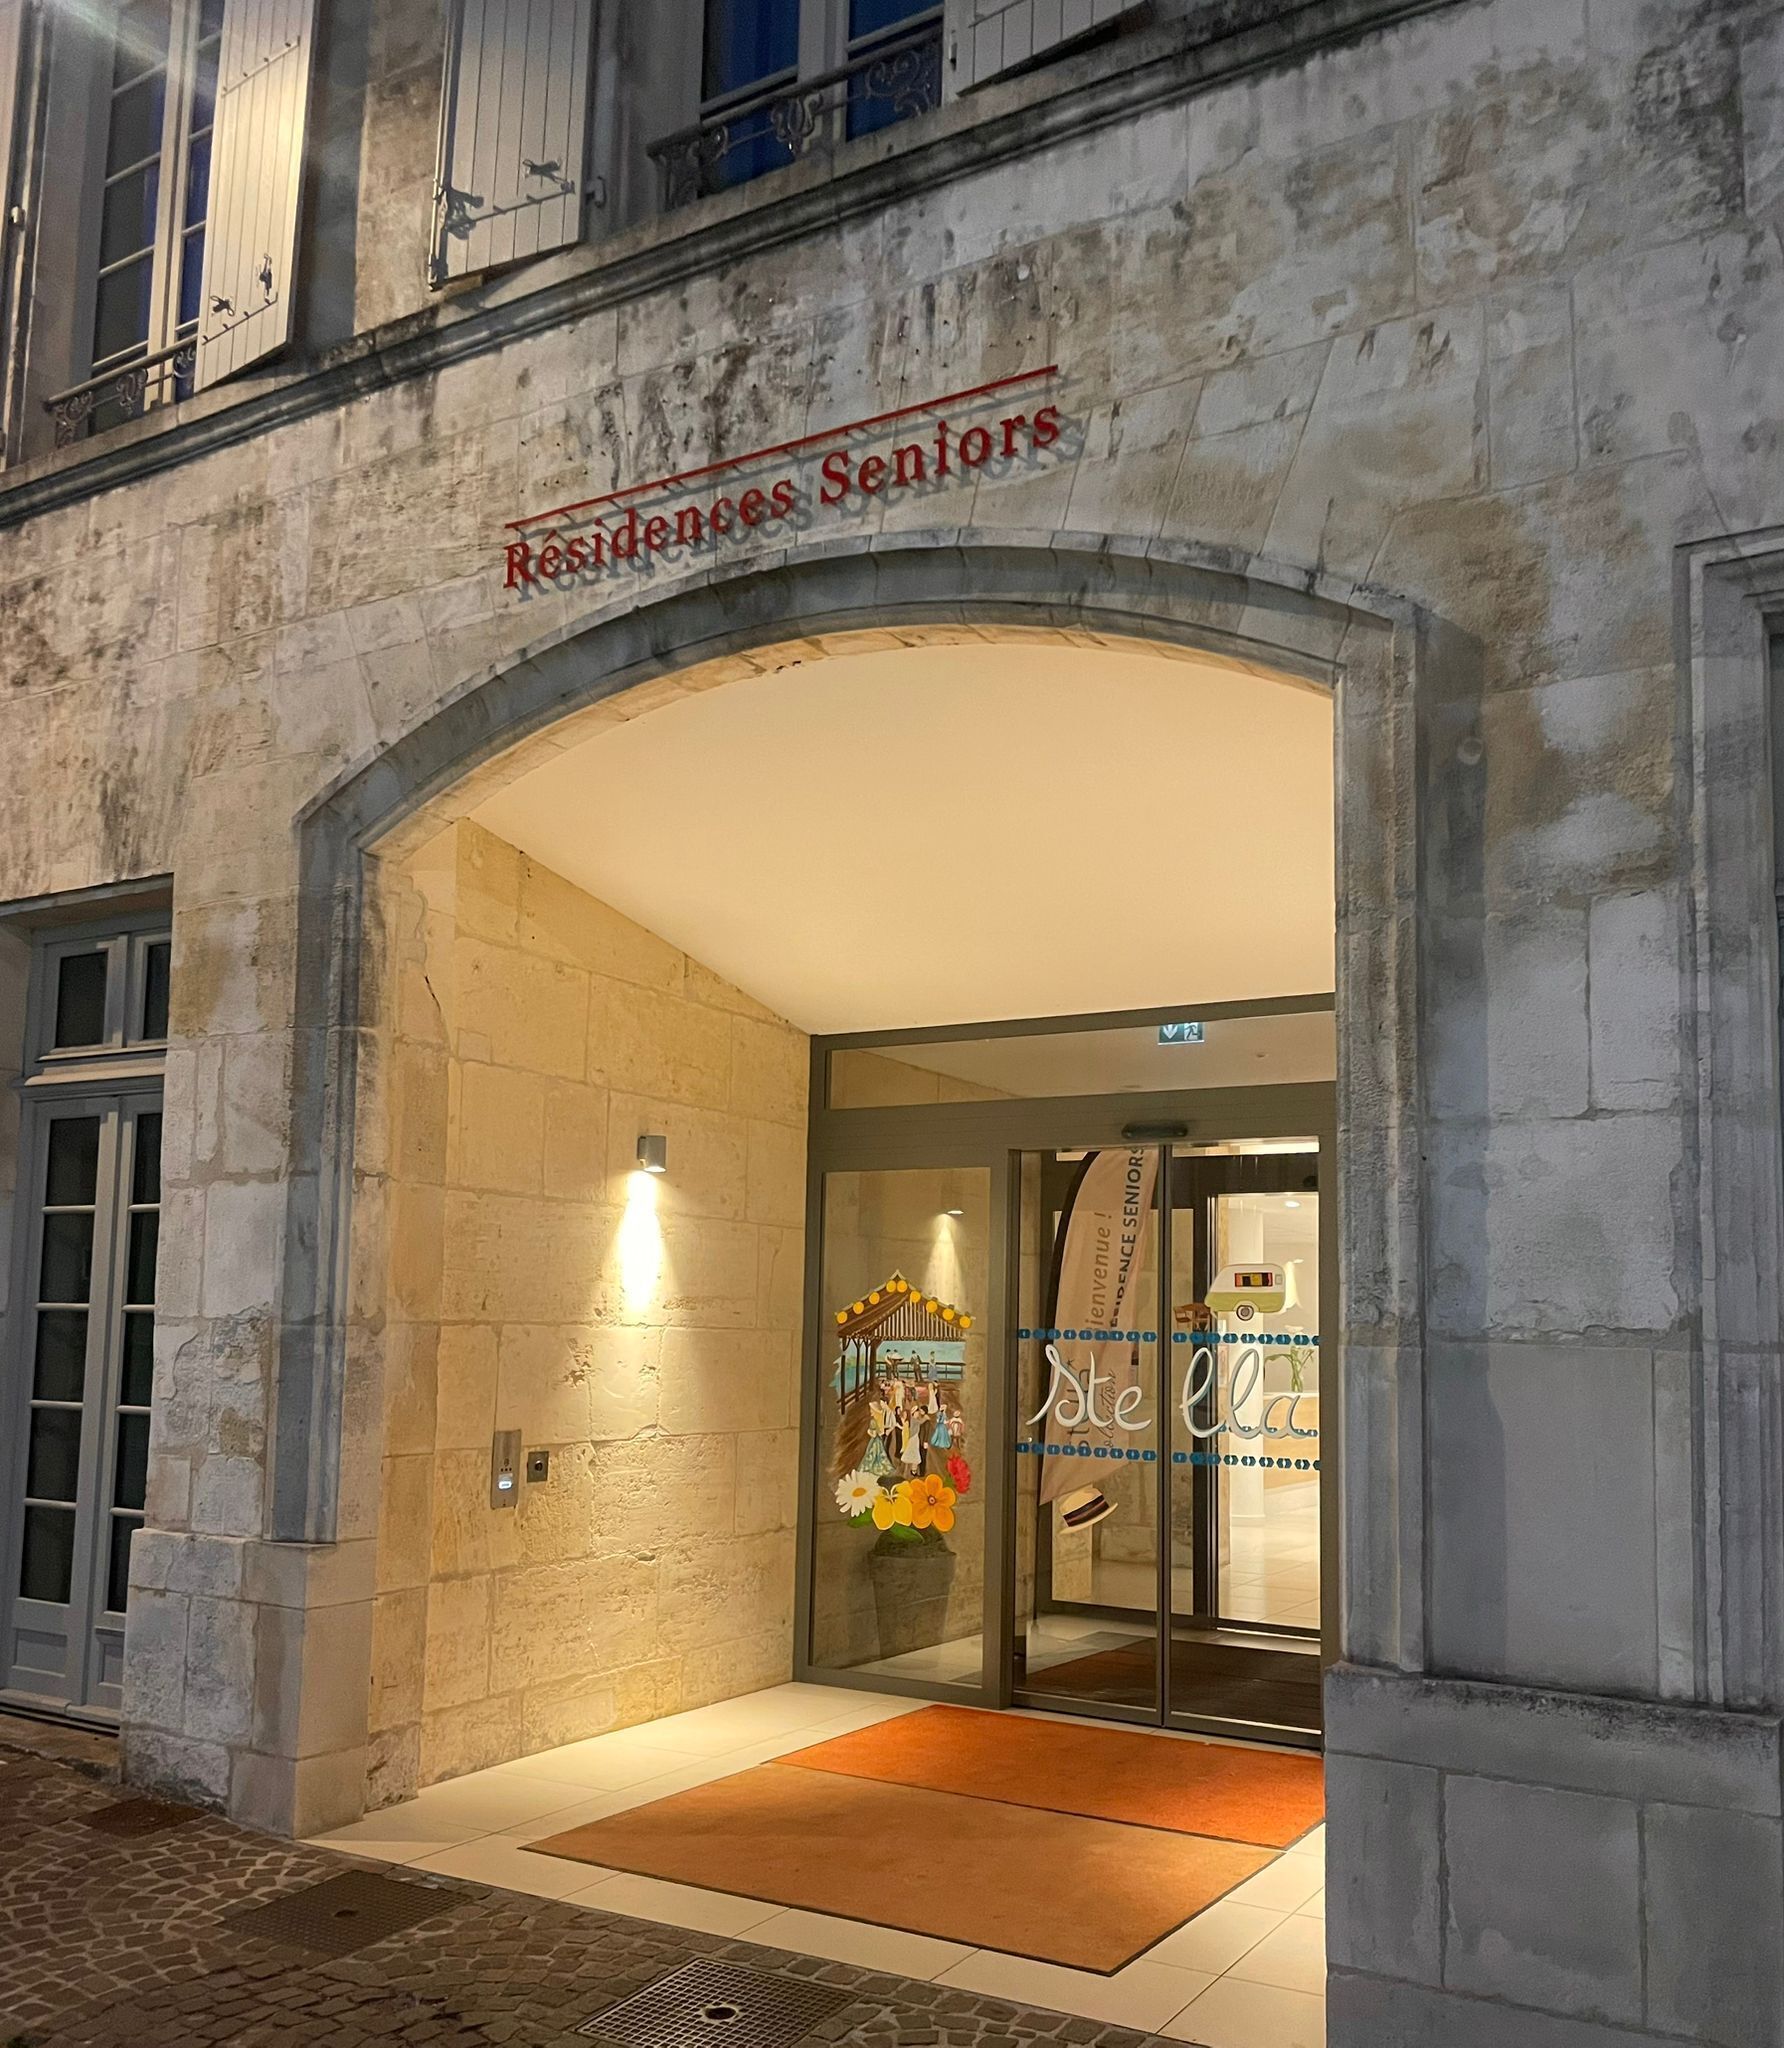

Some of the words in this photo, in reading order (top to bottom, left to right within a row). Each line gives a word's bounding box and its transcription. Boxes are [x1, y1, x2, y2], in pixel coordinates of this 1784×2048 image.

[502, 477, 795, 589] Résidences
[818, 404, 1061, 505] Seniors
[1085, 1226, 1111, 1331] ienvenue
[1109, 1233, 1136, 1328] ÉDENCE
[1123, 1146, 1144, 1227] SENIORS
